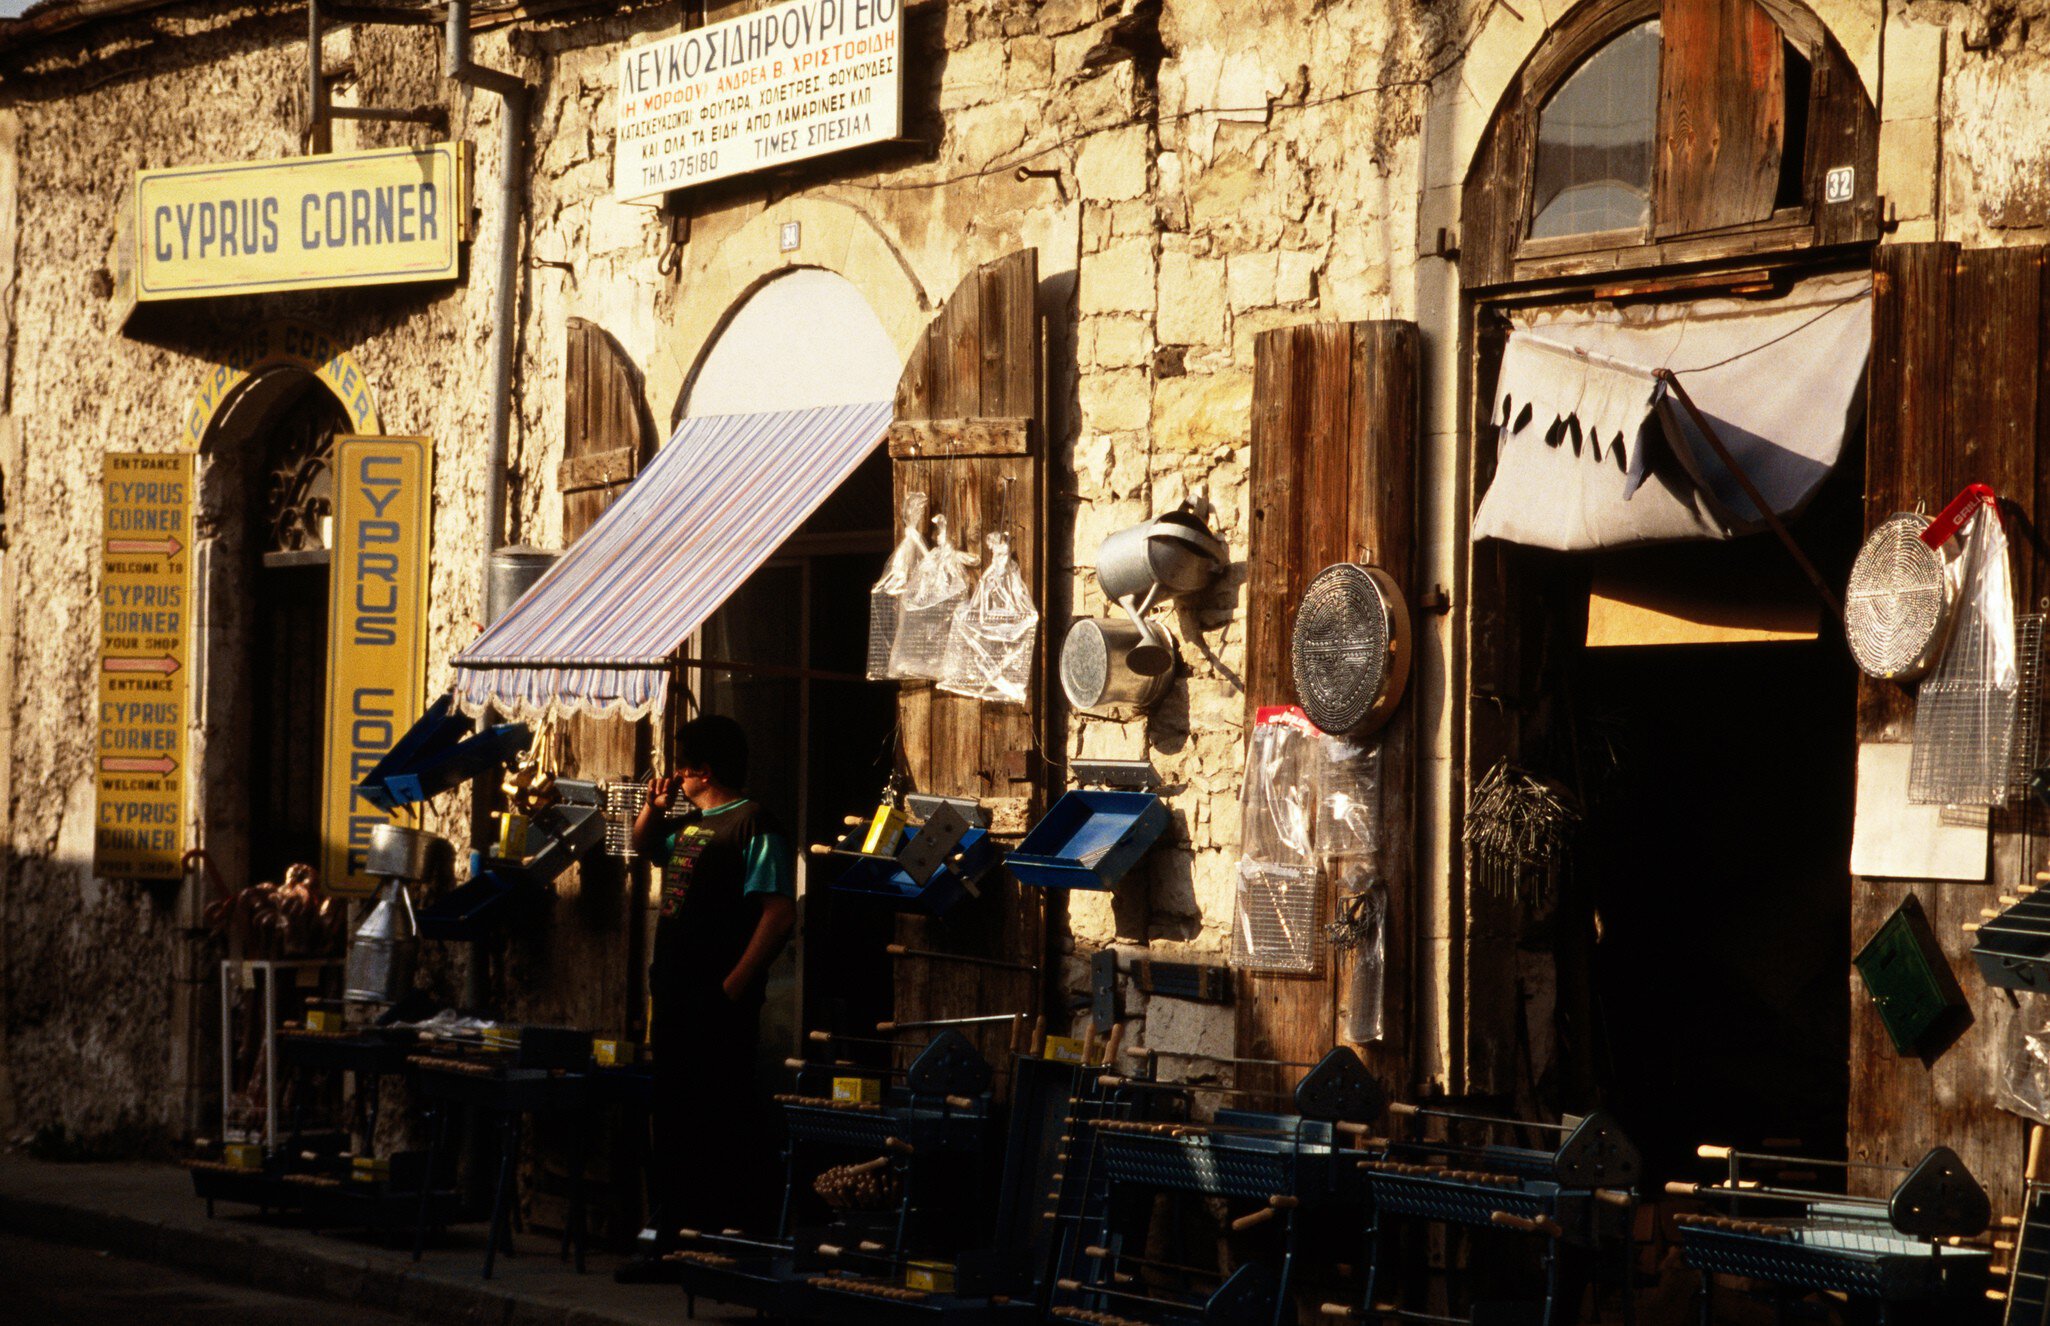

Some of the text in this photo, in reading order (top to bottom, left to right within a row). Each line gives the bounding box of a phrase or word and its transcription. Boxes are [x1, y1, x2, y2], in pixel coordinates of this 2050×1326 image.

[716, 65, 767, 93] ΑΝΔΡΕΑ
[793, 30, 895, 73] ΧΡΙΣΤΟΦΙΔΗ
[828, 56, 893, 86] ΦΟΥΚΟΥΔΕΣ
[642, 141, 659, 160] ΚΑΙ
[664, 134, 686, 154] ΟΛΑ
[692, 129, 705, 147] ΤΑ
[711, 120, 738, 142] ΕΙΔΗ
[746, 113, 771, 134] ΑΠΟ
[776, 93, 846, 126] ΛΑΜΑΡΙΝΕΣ
[754, 113, 871, 160] ΤΙΜΕΣ ΣΠΕΣΙΑΛ
[1829, 171, 1851, 198] 32
[154, 182, 438, 262] CYPRUS CORNER
[113, 458, 180, 471] ENTRANCE
[108, 481, 184, 504] CYPRUS
[108, 508, 182, 531] CORNER
[353, 455, 403, 646] CYPRUS
[104, 562, 183, 575] WELCOME TO
[103, 584, 181, 607] CYPRUS
[103, 611, 179, 634] CORNER
[105, 637, 180, 650] YOUR SHOP
[108, 679, 173, 691] ENTRANCE
[101, 702, 178, 724] CYPRUS
[101, 728, 177, 751] CORNER
[102, 779, 177, 791] WELCOME TO
[101, 802, 177, 824] CYPRUS
[99, 828, 175, 851] CORNER
